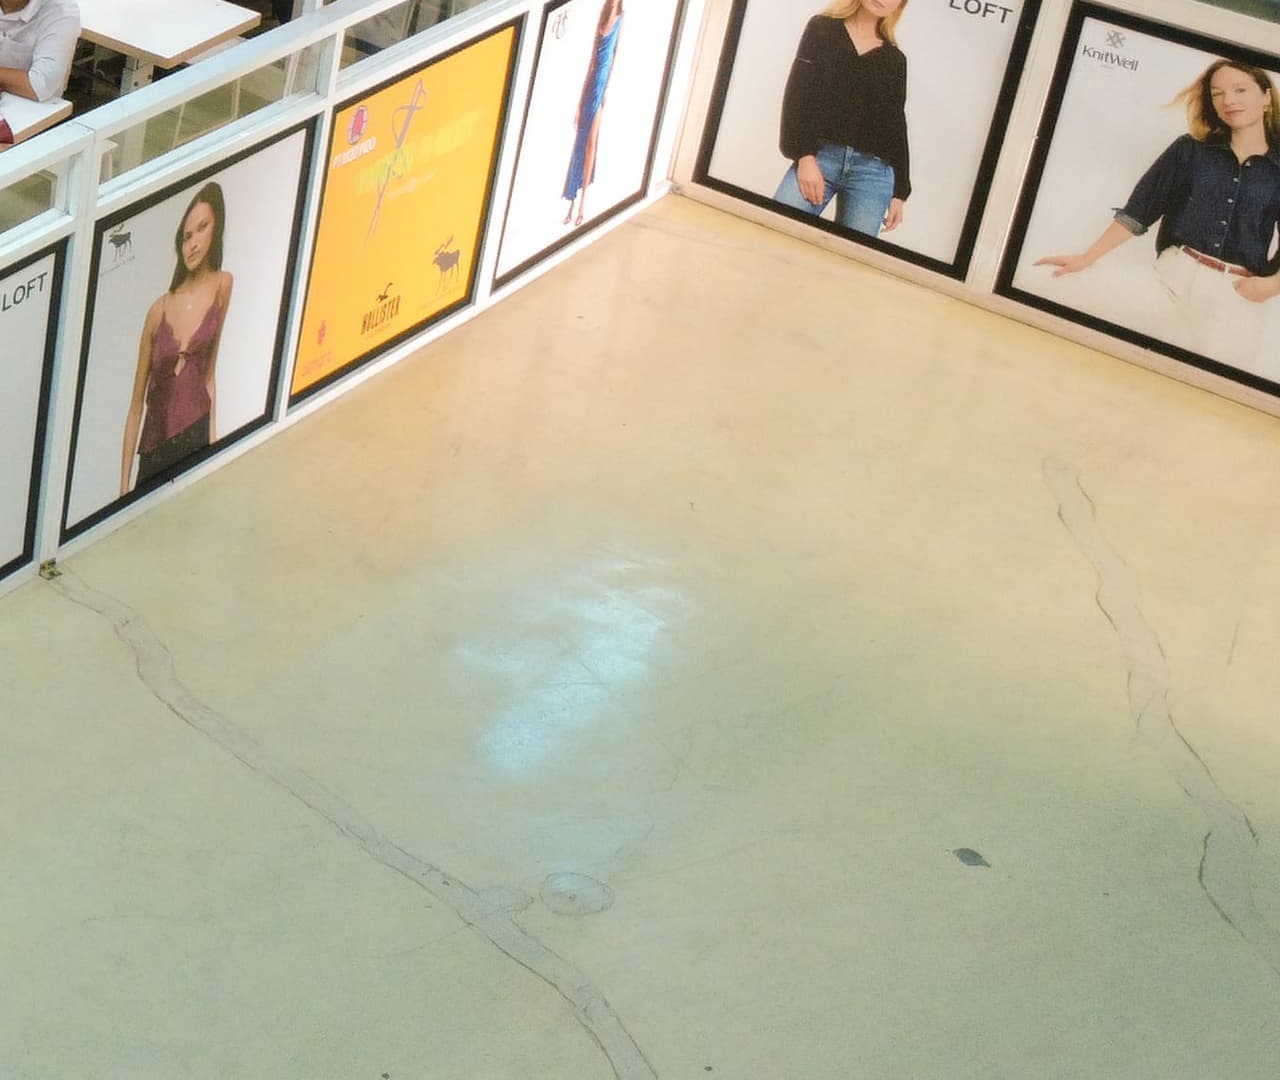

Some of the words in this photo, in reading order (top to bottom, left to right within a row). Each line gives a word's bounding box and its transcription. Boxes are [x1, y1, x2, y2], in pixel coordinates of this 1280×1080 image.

[1082, 44, 1140, 72] KnitWell
[1, 271, 49, 312] LOFT
[360, 294, 402, 336] HOLLISTER
